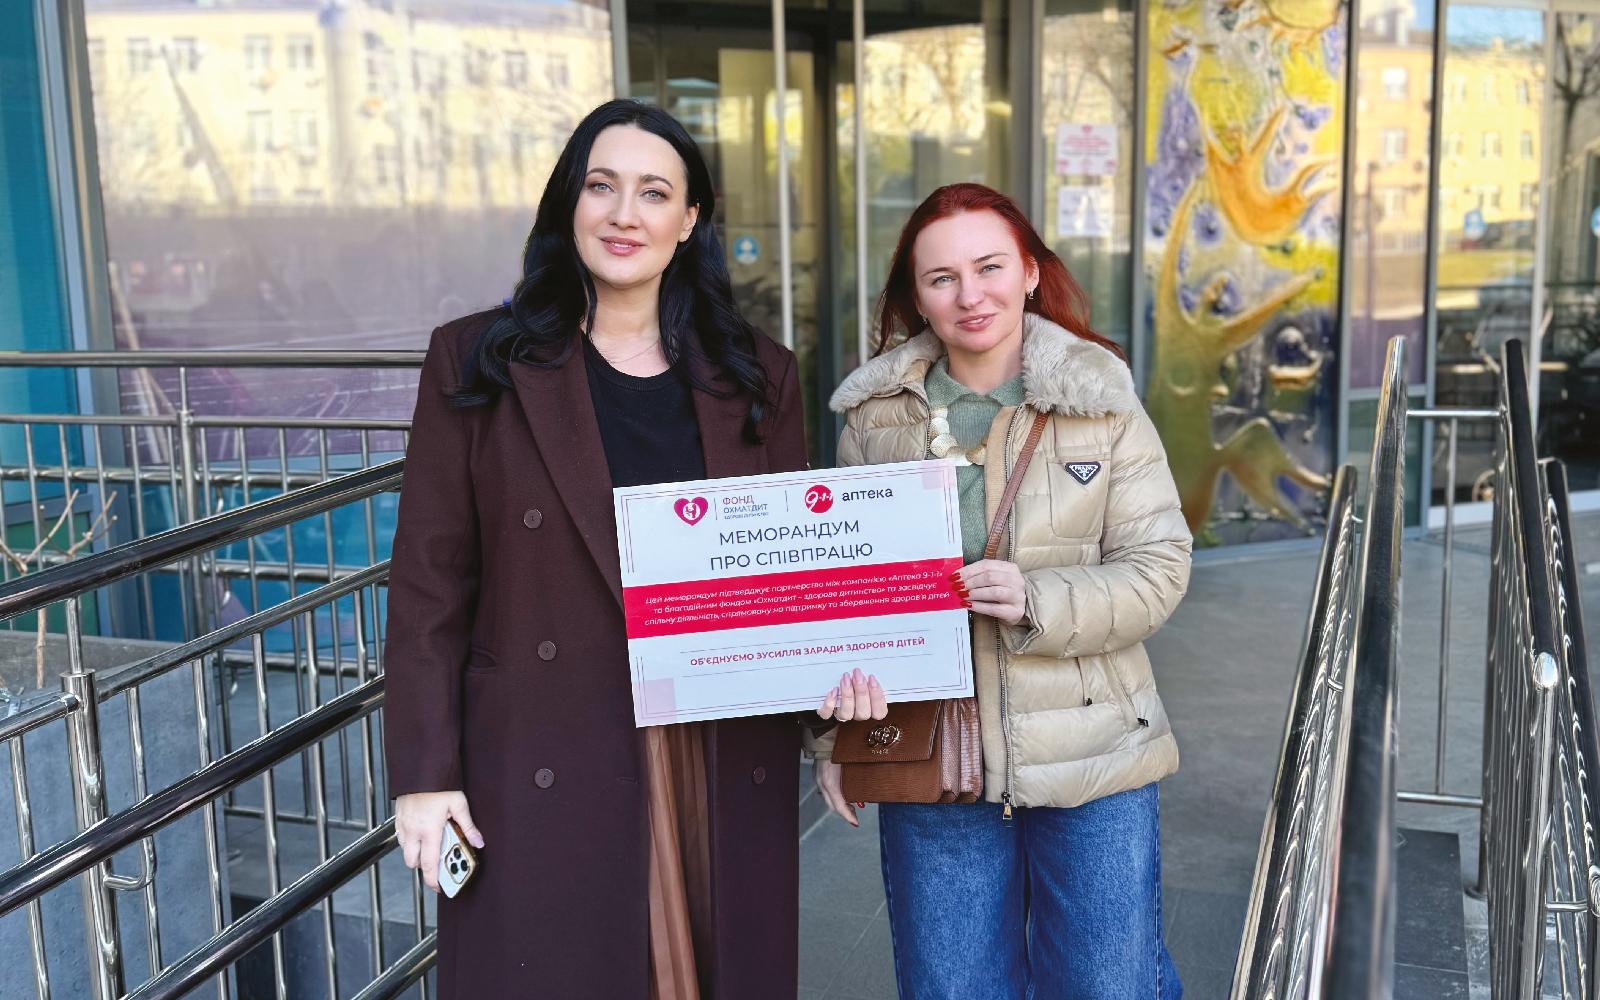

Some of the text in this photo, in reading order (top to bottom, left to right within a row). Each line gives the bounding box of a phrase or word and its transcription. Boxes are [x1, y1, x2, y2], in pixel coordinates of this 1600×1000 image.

[723, 495, 754, 505] ФОНД
[842, 488, 893, 501] аптека
[723, 503, 768, 514] ОХМАТДИТ
[719, 520, 859, 546] МЕМОРАНДУМ
[711, 543, 873, 570] ПРО СПІВПРАЦЮ
[645, 596, 662, 605] Цей
[664, 592, 717, 603] меморандум
[719, 586, 770, 598] підтверджує
[772, 582, 823, 593] партнерство
[842, 576, 887, 586] компанією
[664, 602, 717, 613] благодійним
[719, 600, 752, 609] фондом
[804, 591, 837, 601] здорове
[898, 582, 937, 591] засвідчує
[644, 616, 676, 626] спільну
[721, 608, 771, 619] спрямовану
[785, 602, 826, 613] підтримку
[839, 597, 890, 607] збереження
[928, 591, 950, 600] дітей
[690, 637, 925, 666] ОБ'ЄДНУЄМО ЗУСИЛЛЯ ЗАРАДИ ЗДОРОВ'Я ДІТЕЙ
